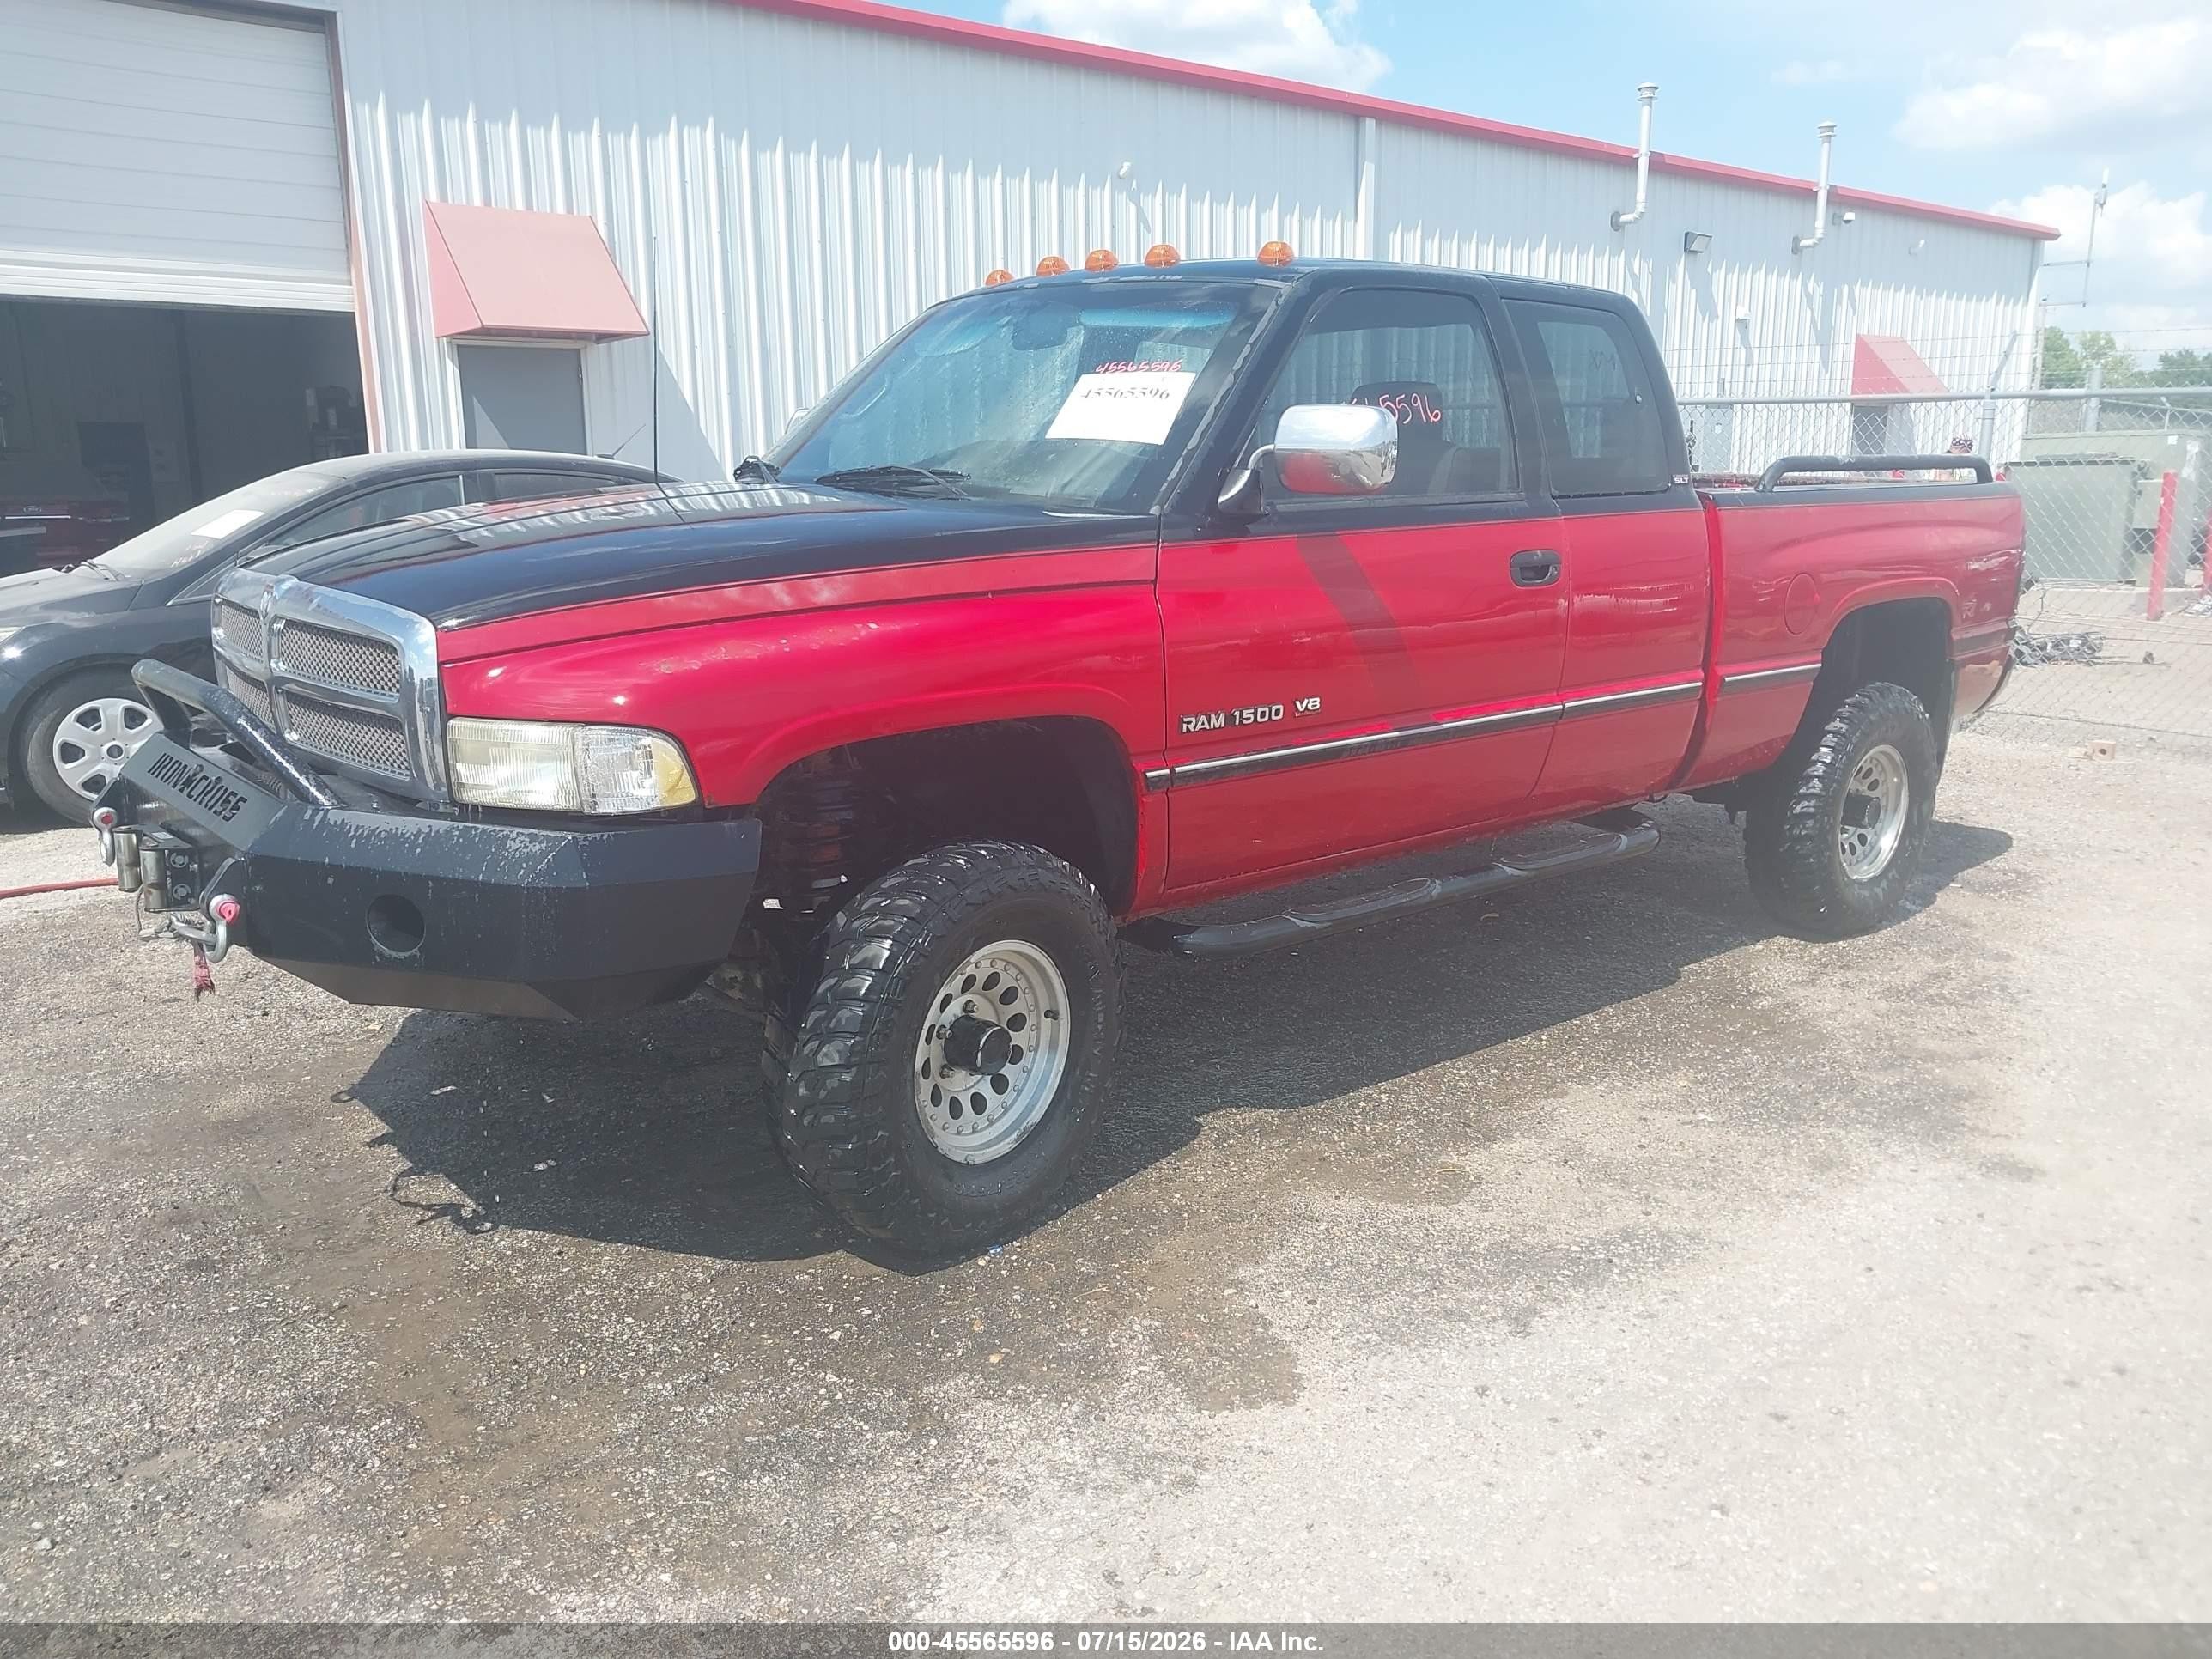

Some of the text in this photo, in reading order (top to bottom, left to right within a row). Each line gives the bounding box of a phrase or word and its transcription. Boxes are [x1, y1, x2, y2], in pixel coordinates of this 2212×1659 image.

[1095, 359, 1182, 374] 45565596
[1181, 696, 1321, 733] RAM 1500 V8
